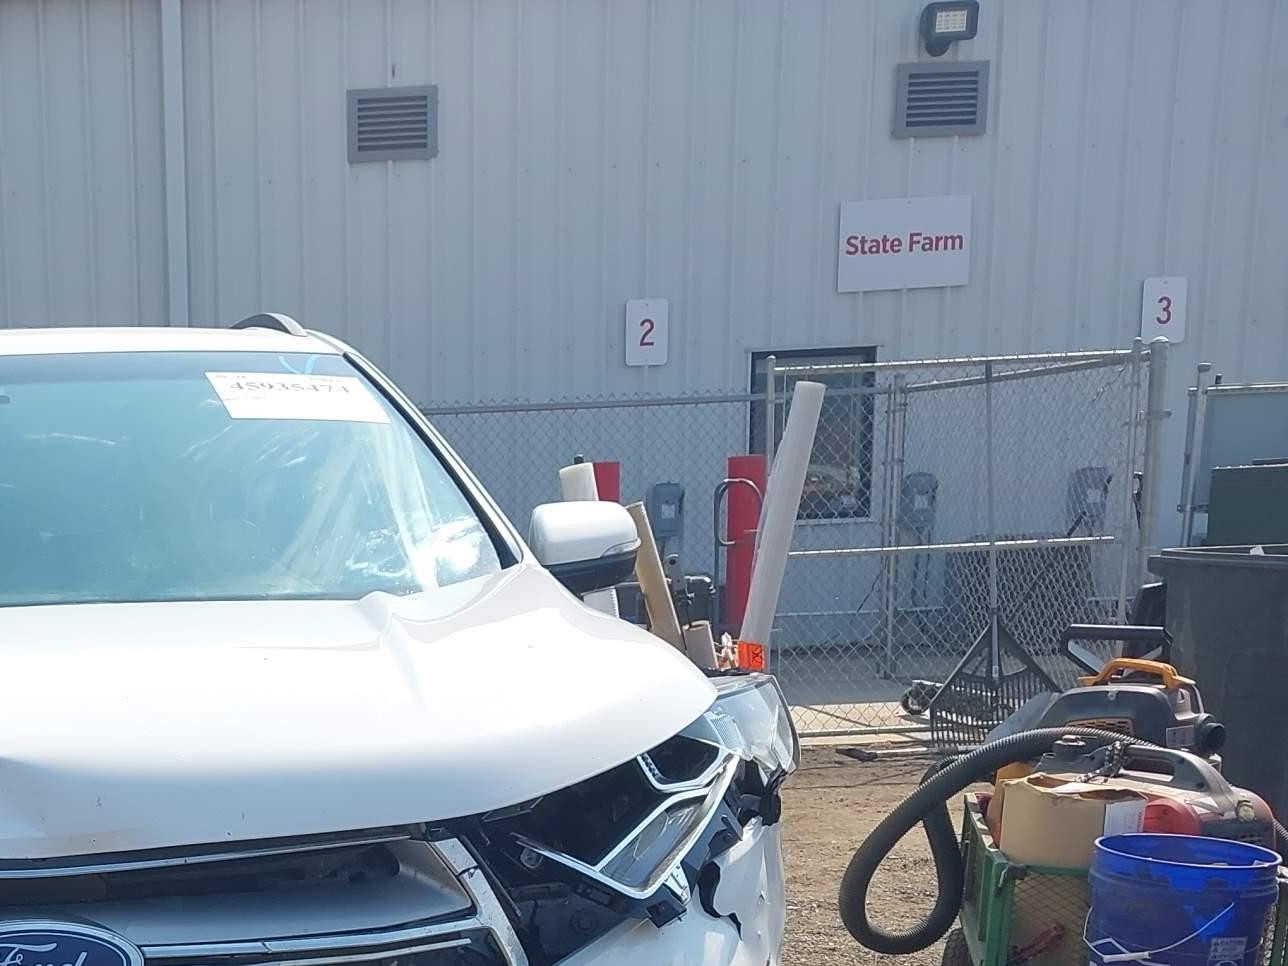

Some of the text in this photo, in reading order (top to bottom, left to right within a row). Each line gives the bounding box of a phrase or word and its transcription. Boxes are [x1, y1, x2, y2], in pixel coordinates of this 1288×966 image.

[845, 232, 964, 256] State Farm
[1156, 296, 1172, 325] 3
[639, 318, 655, 347] 2
